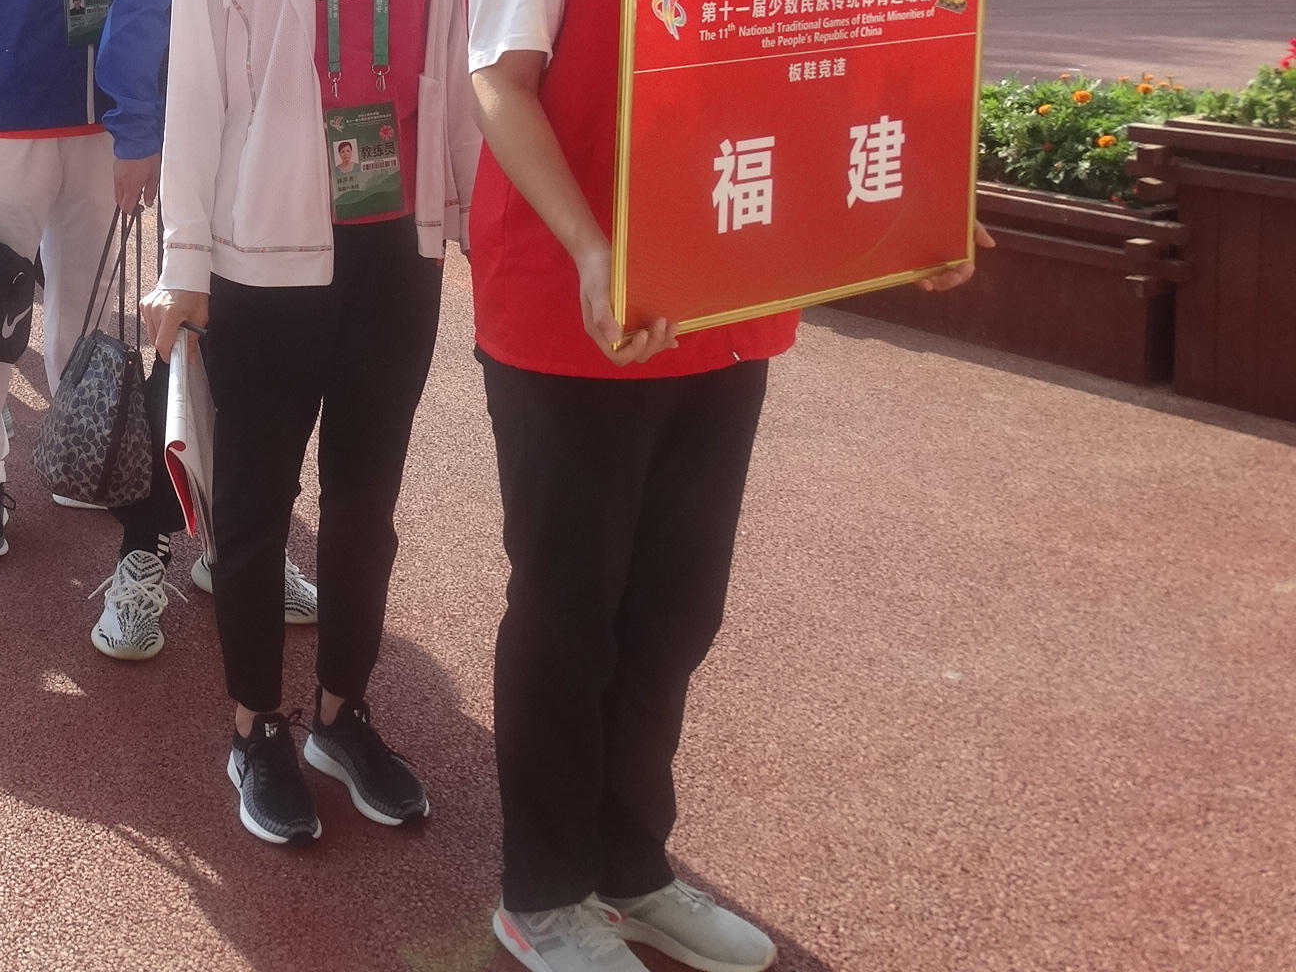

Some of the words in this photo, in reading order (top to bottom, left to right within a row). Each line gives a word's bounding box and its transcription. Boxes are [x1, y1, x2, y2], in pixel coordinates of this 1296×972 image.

[700, 29, 716, 41] The
[718, 23, 736, 40] 11th
[738, 24, 775, 37] National
[777, 18, 821, 33] Traditional
[823, 16, 850, 29] Games
[851, 14, 861, 25] of
[862, 12, 885, 24] Ethnic
[887, 9, 925, 22] Minorities
[926, 6, 935, 17] of
[761, 37, 775, 48] the
[777, 33, 812, 48] People's
[814, 29, 848, 44] Republic
[850, 28, 859, 38] of
[860, 26, 882, 37] China
[788, 57, 847, 82] 板鞋竞速
[712, 135, 776, 234] 福
[846, 114, 905, 210] 建
